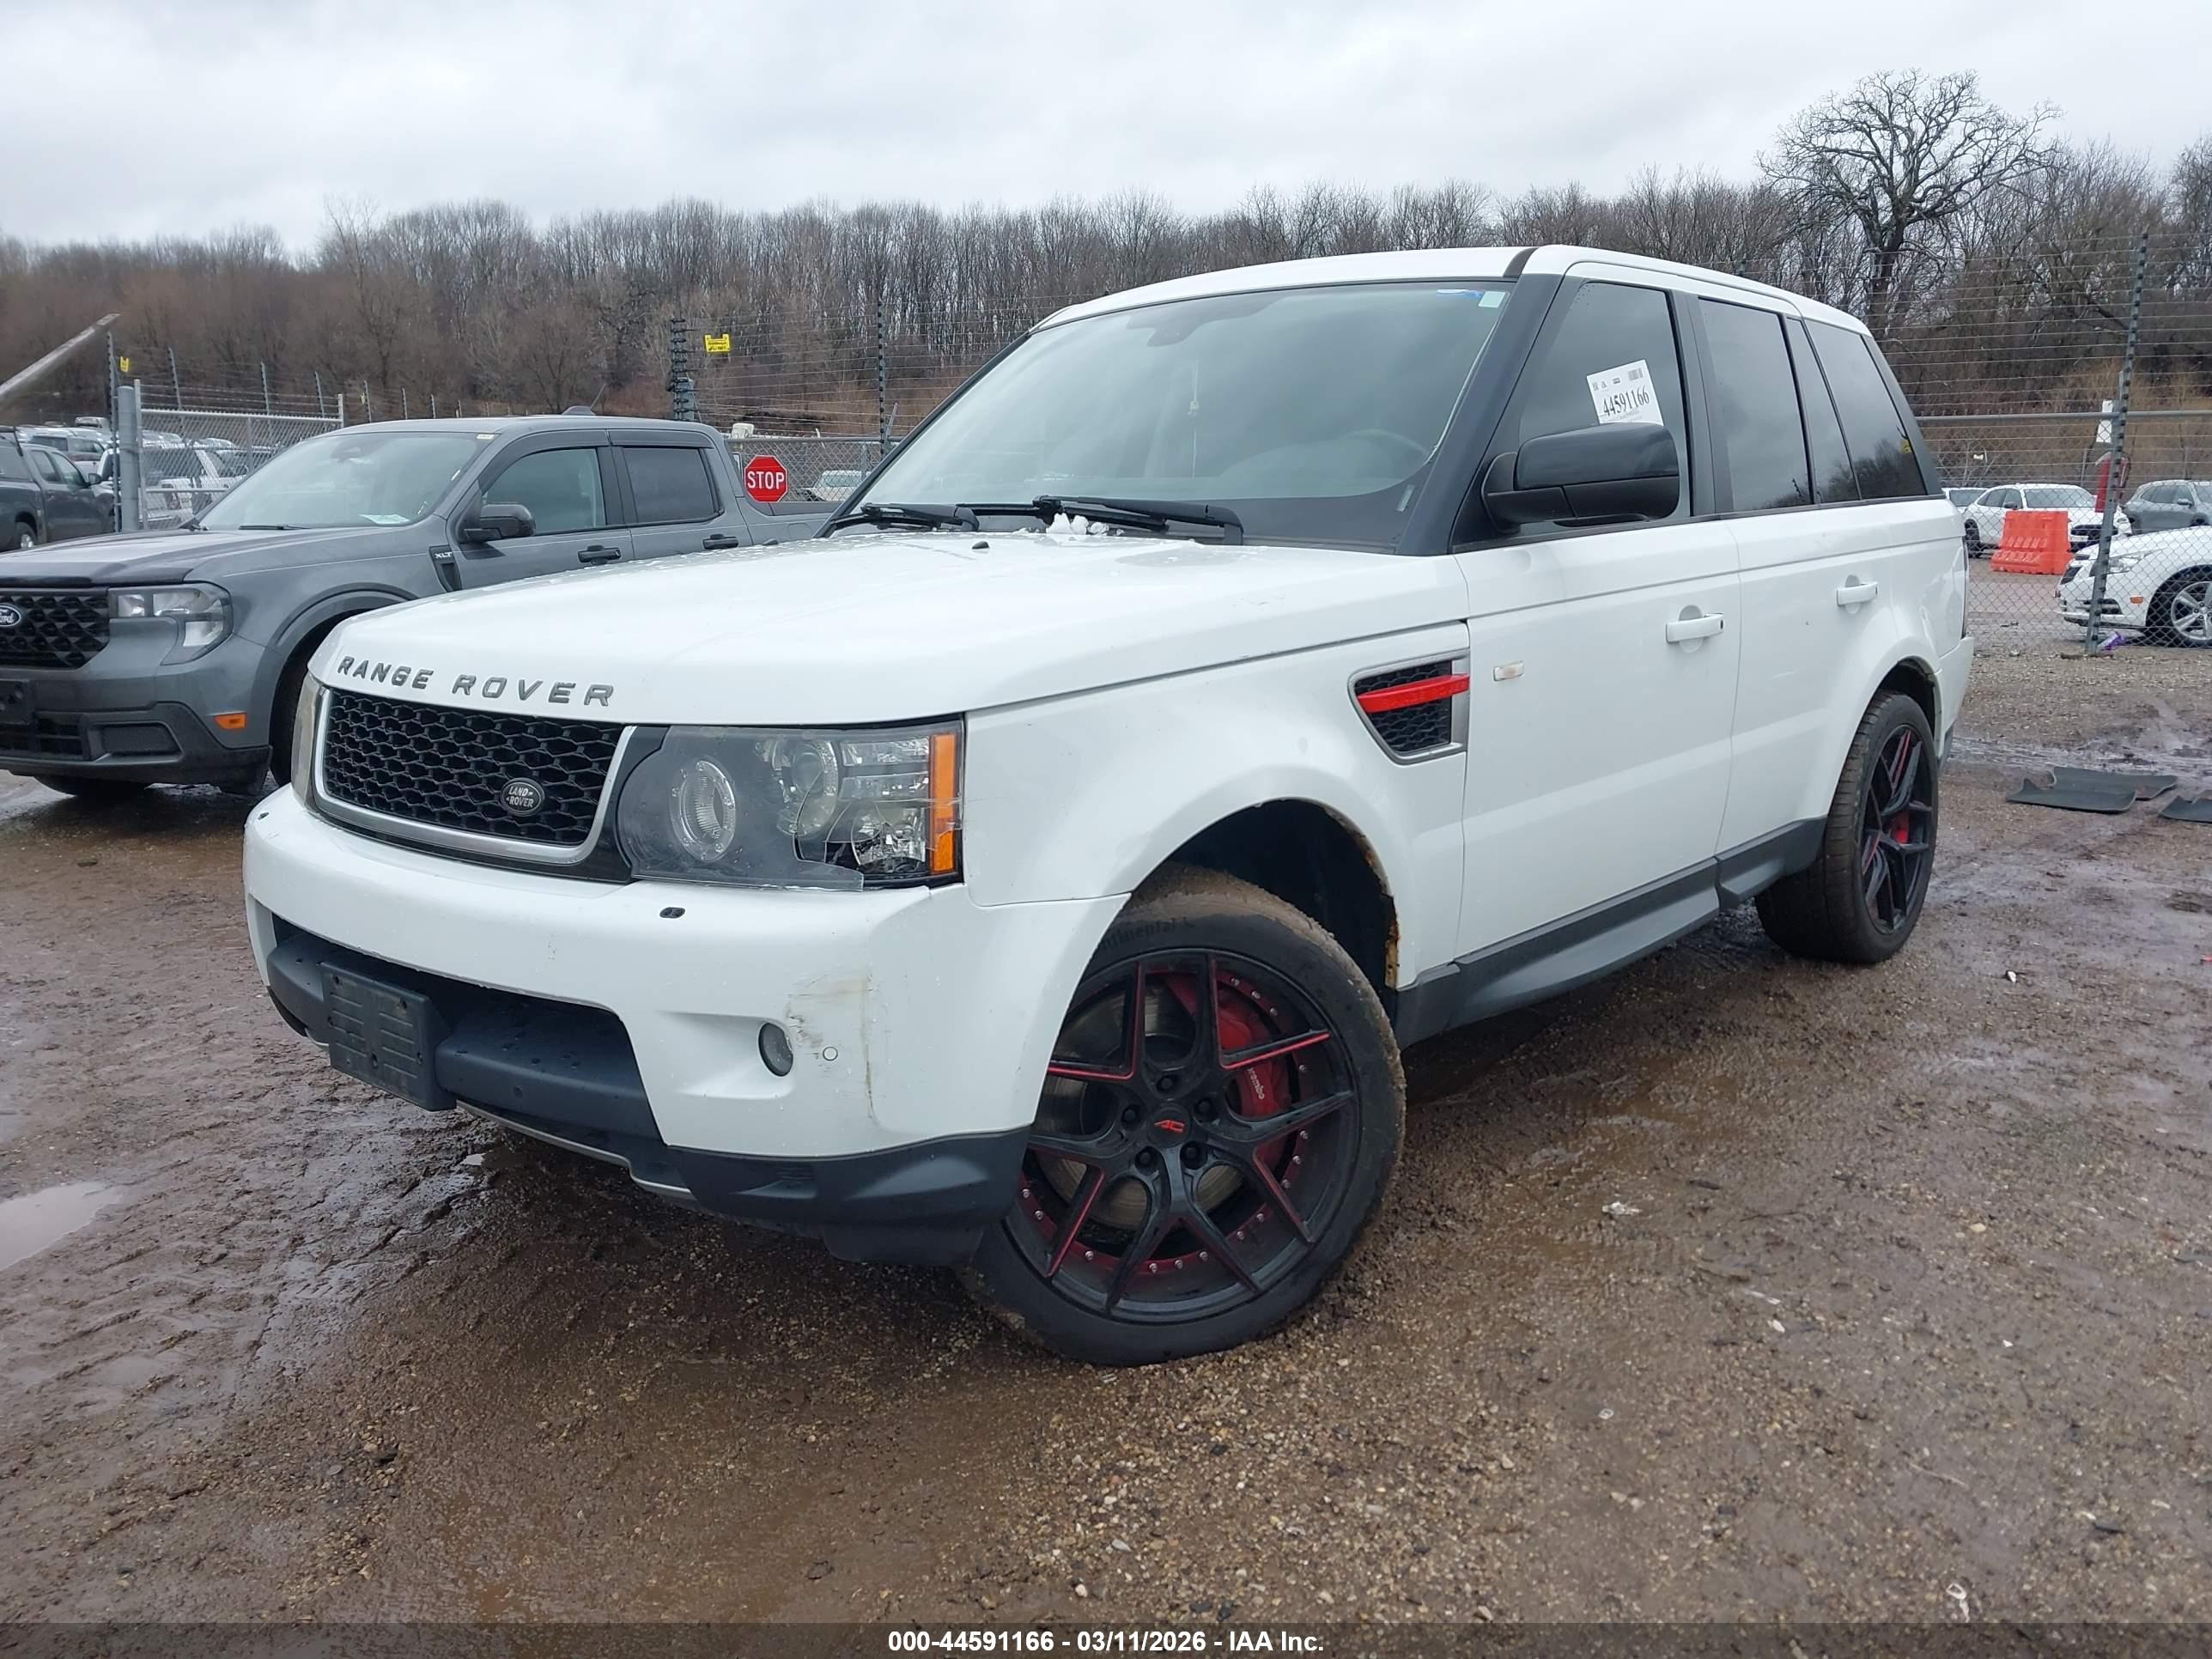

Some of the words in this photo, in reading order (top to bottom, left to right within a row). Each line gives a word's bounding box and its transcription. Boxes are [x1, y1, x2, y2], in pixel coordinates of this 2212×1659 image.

[1603, 385, 1650, 416] 44591166
[747, 471, 785, 489] STOP
[337, 655, 434, 690] RANGE
[452, 674, 615, 707] ROVER
[508, 796, 534, 807] ROVER
